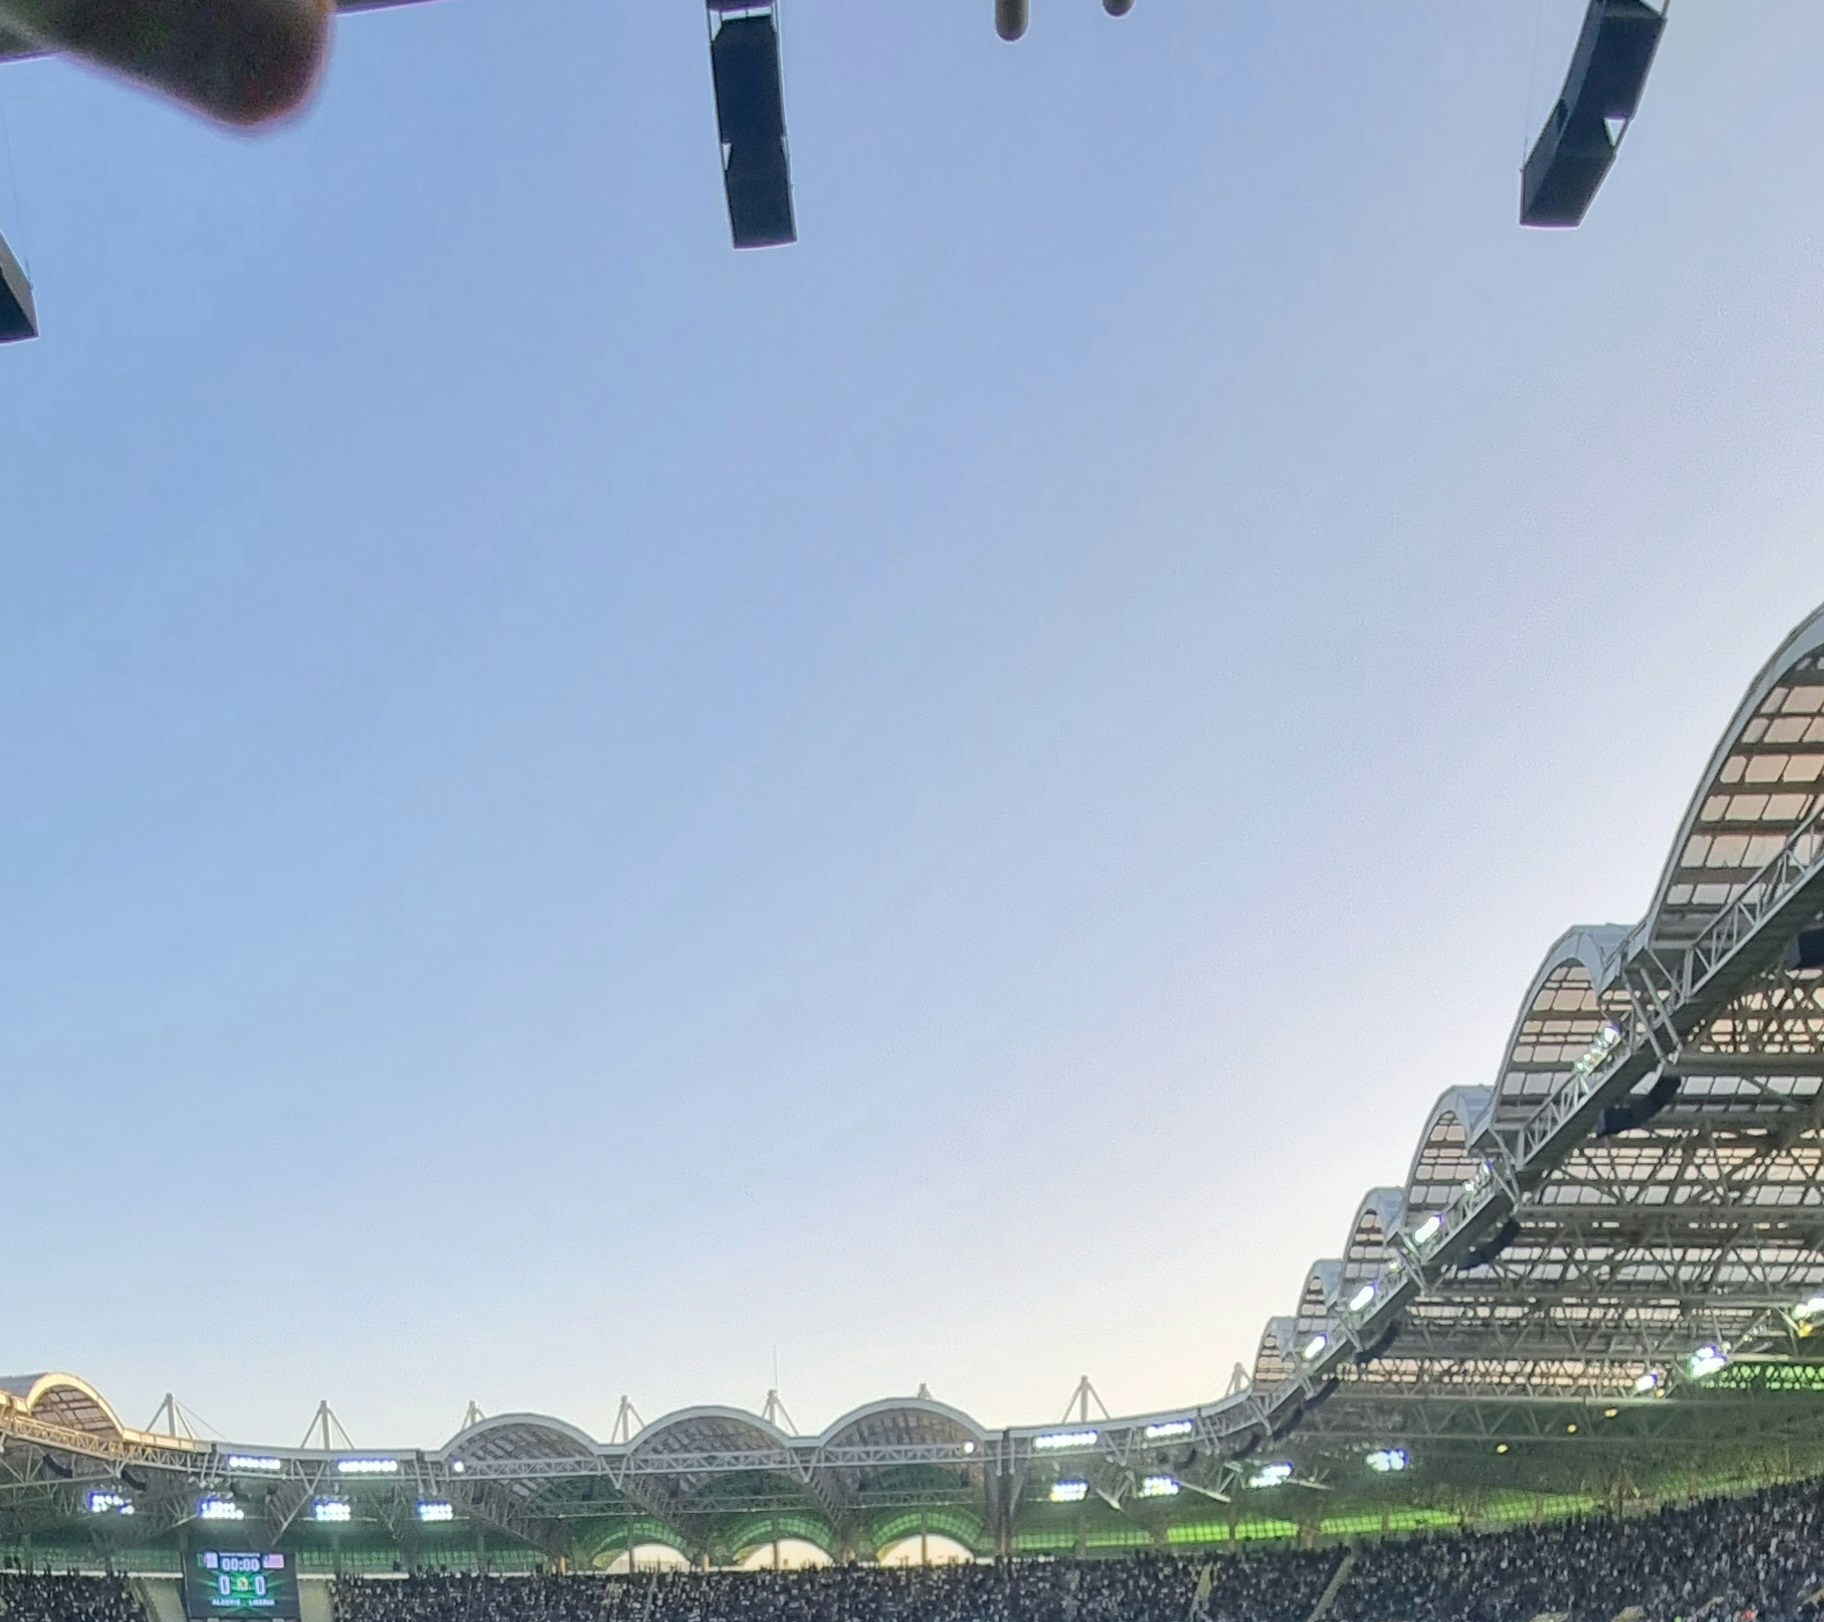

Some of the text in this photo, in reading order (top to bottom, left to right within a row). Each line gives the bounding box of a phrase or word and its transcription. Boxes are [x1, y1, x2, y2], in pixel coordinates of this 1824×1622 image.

[222, 1558, 260, 1572] 00:00
[219, 1575, 266, 1595] 0 0
